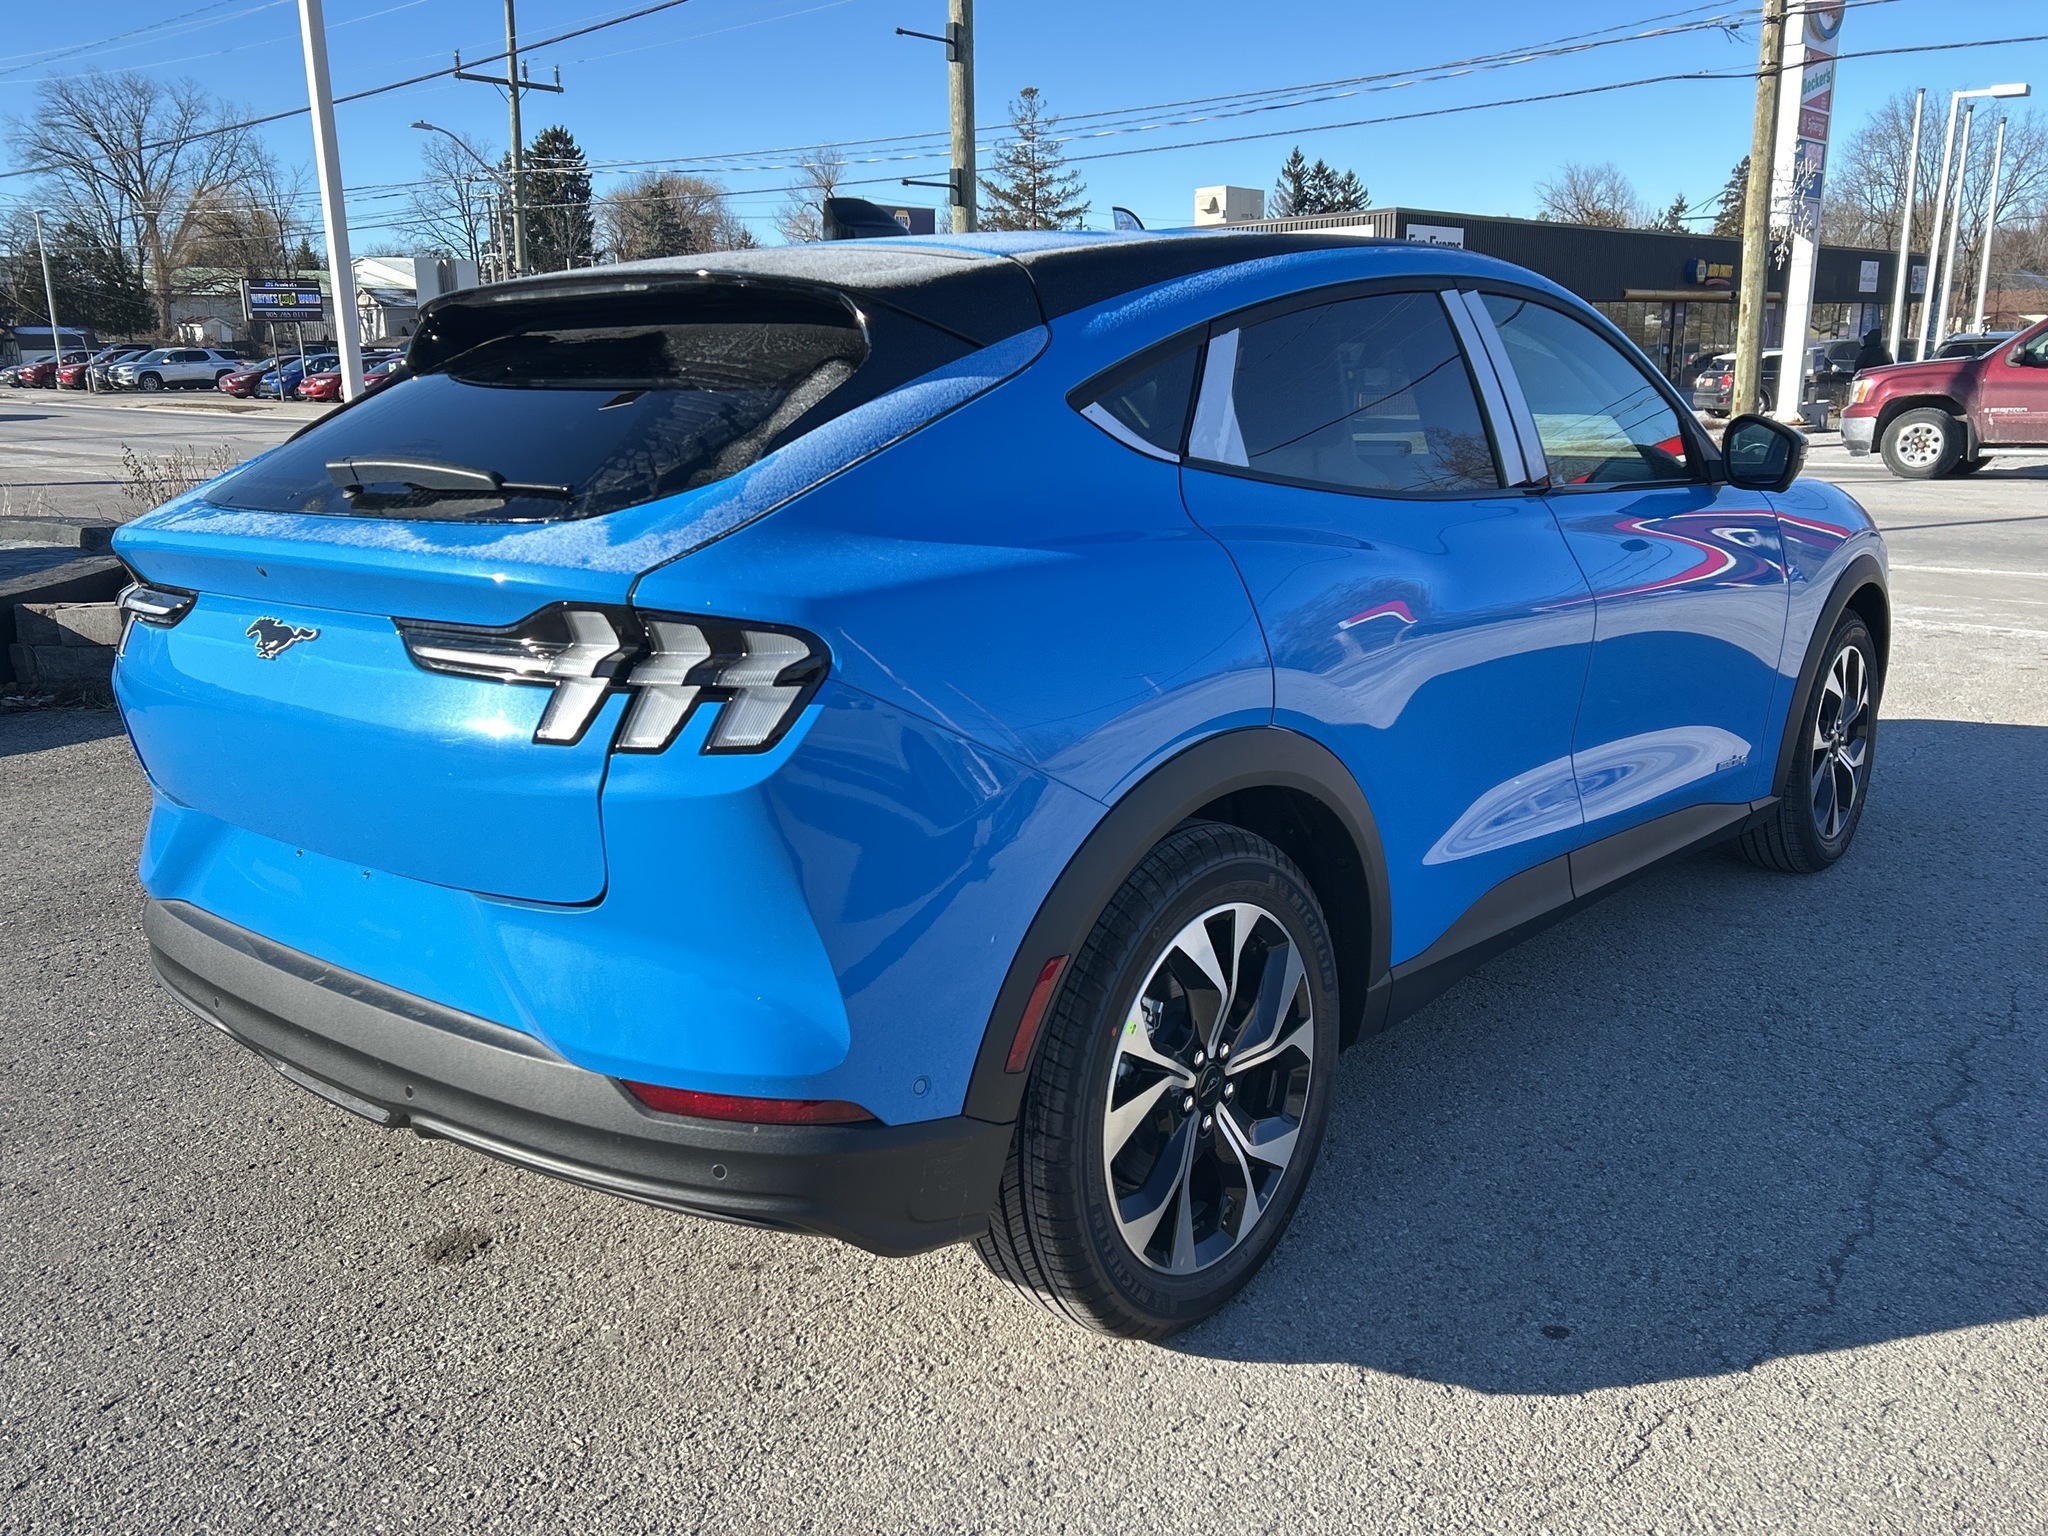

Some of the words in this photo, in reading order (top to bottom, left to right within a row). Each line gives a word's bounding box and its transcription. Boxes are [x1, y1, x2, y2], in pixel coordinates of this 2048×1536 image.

[1802, 70, 1831, 95] Becker's
[298, 294, 320, 304] WORLD
[1289, 892, 1333, 985] MICHELIN
[1094, 1211, 1151, 1303] MICHELIN
